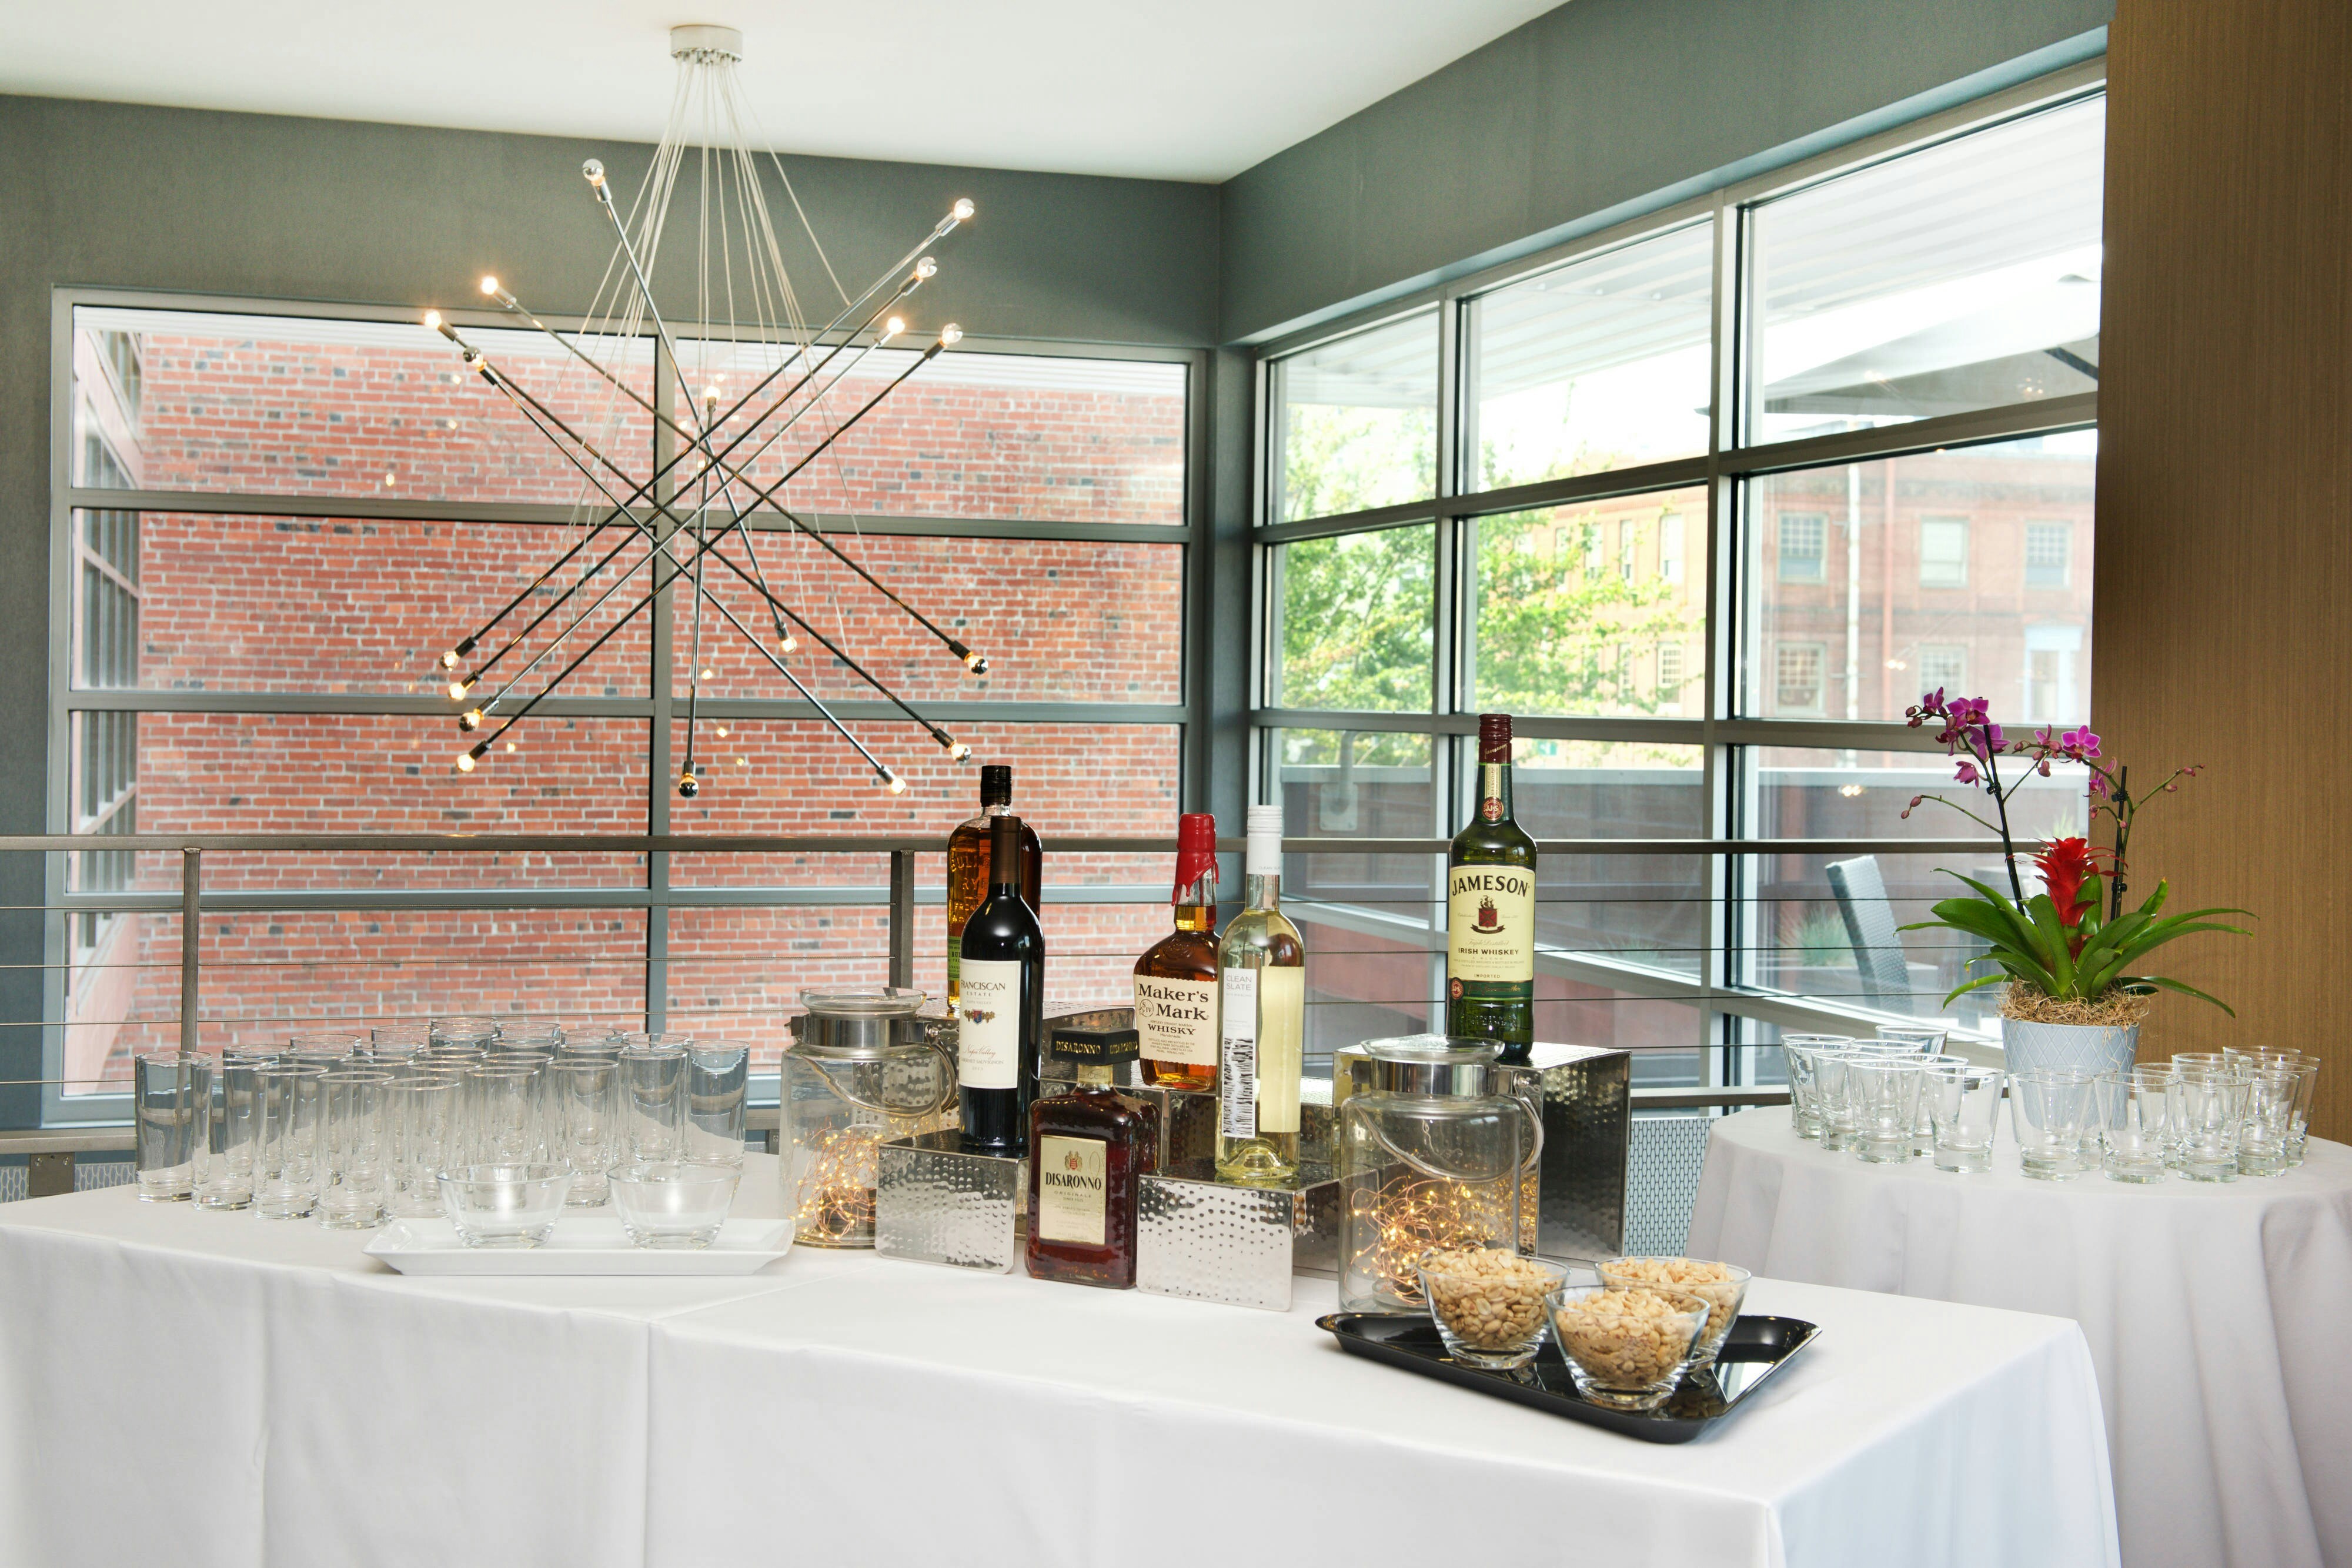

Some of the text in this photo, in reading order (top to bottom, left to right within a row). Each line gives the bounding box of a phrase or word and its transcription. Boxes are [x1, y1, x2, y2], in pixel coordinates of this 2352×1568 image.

[1452, 875, 1528, 897] JAMESON
[961, 979, 1005, 991] FRANCISCAN
[1138, 983, 1209, 1003] Maker's
[1156, 1003, 1208, 1021] Mark
[1147, 1024, 1197, 1035] WHISKY
[1055, 1041, 1101, 1055] DISARONNO
[1110, 1041, 1138, 1054] DISARONNO
[1045, 1171, 1101, 1191] DISARONNO
[1054, 1190, 1092, 1198] ORIGINALE
